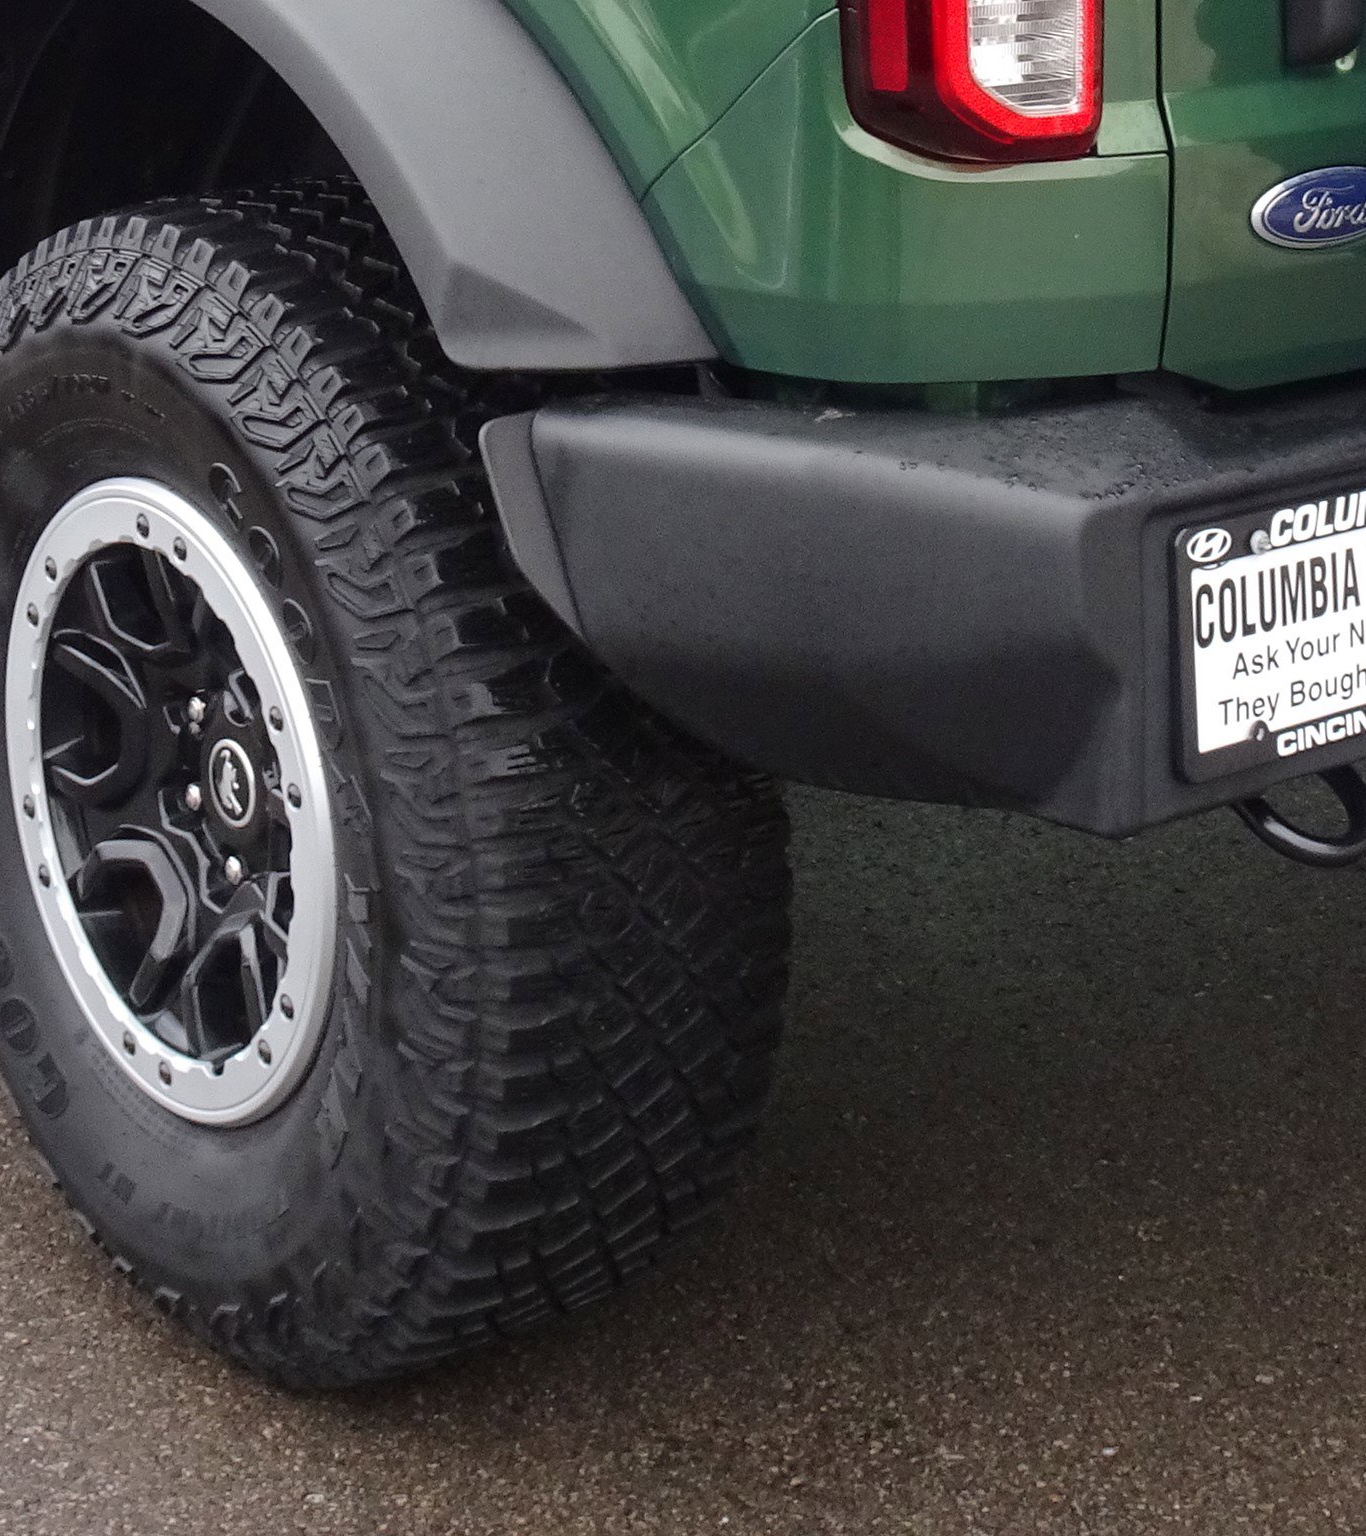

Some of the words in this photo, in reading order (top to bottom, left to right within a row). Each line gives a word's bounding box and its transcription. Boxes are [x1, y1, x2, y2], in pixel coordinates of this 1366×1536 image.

[1195, 547, 1361, 649] COLUMBIA
[1232, 644, 1279, 680] Ask
[1286, 632, 1340, 665] Your
[1218, 692, 1279, 727] They
